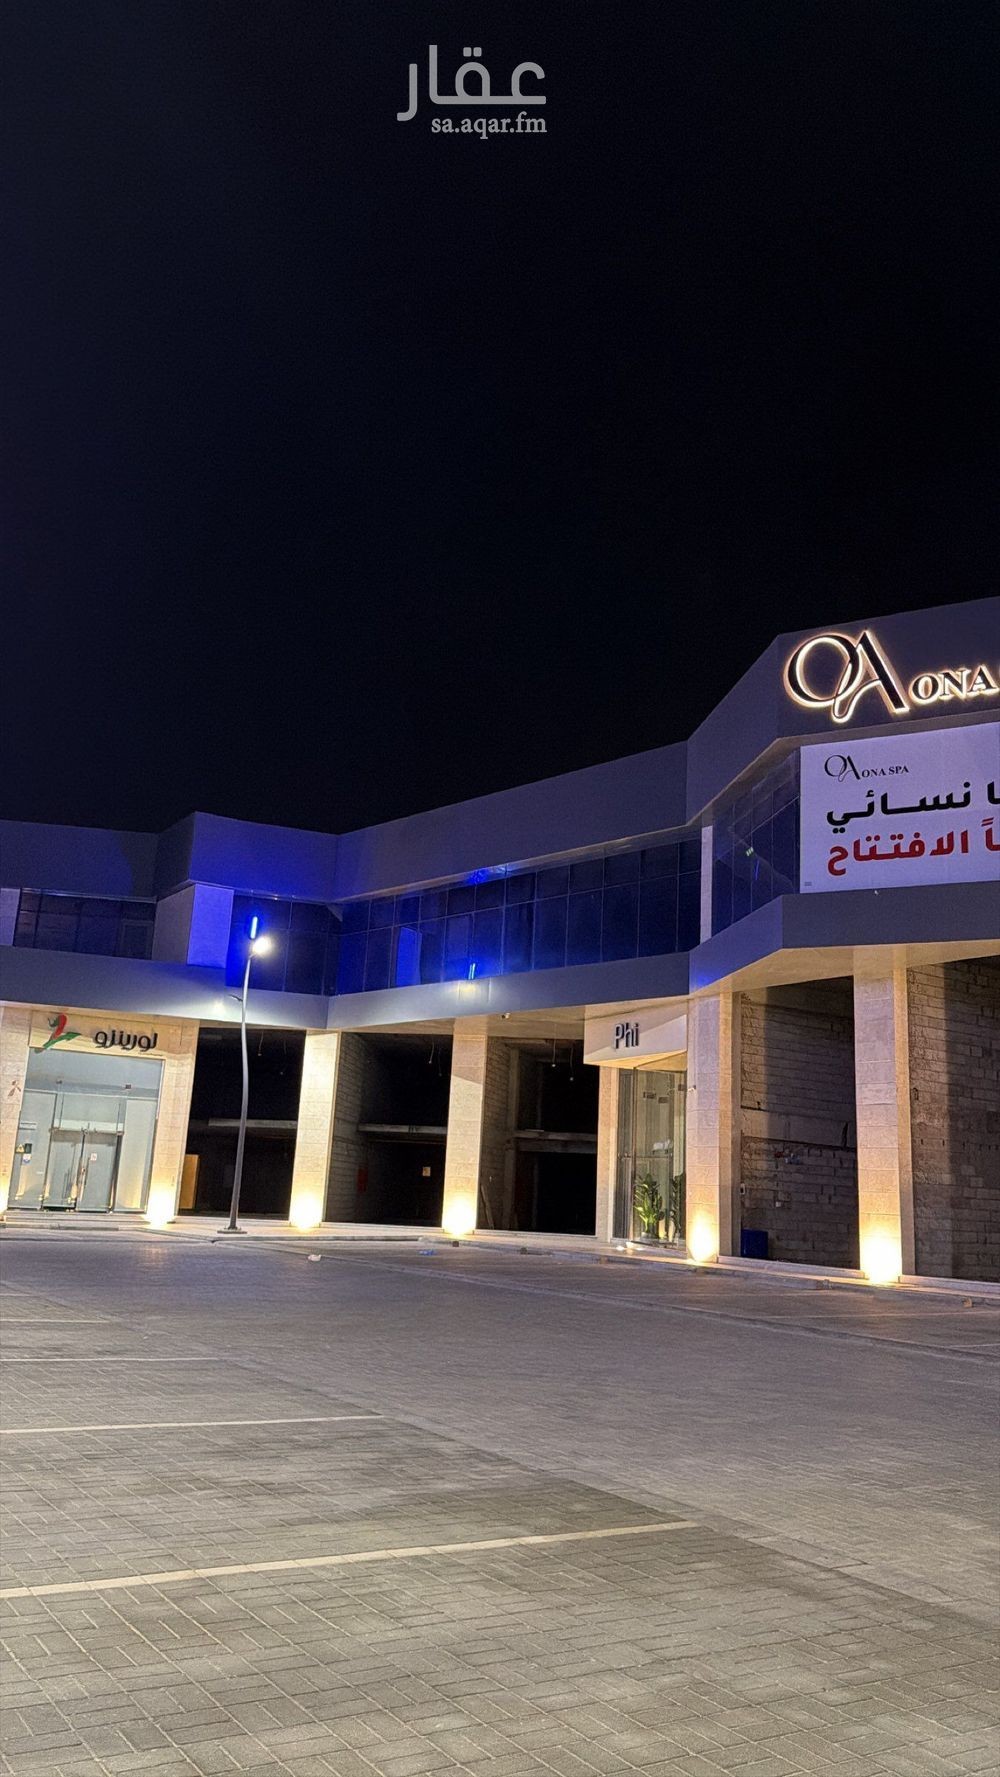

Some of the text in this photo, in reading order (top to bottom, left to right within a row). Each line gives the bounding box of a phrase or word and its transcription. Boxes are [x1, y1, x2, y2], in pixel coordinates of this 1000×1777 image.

[909, 664, 1000, 705] ONA
[861, 768, 887, 778] ONA
[888, 765, 910, 776] SPA
[826, 781, 971, 834] نسائي
[827, 829, 969, 876] الافتتاح
[614, 1022, 640, 1050] Phi
